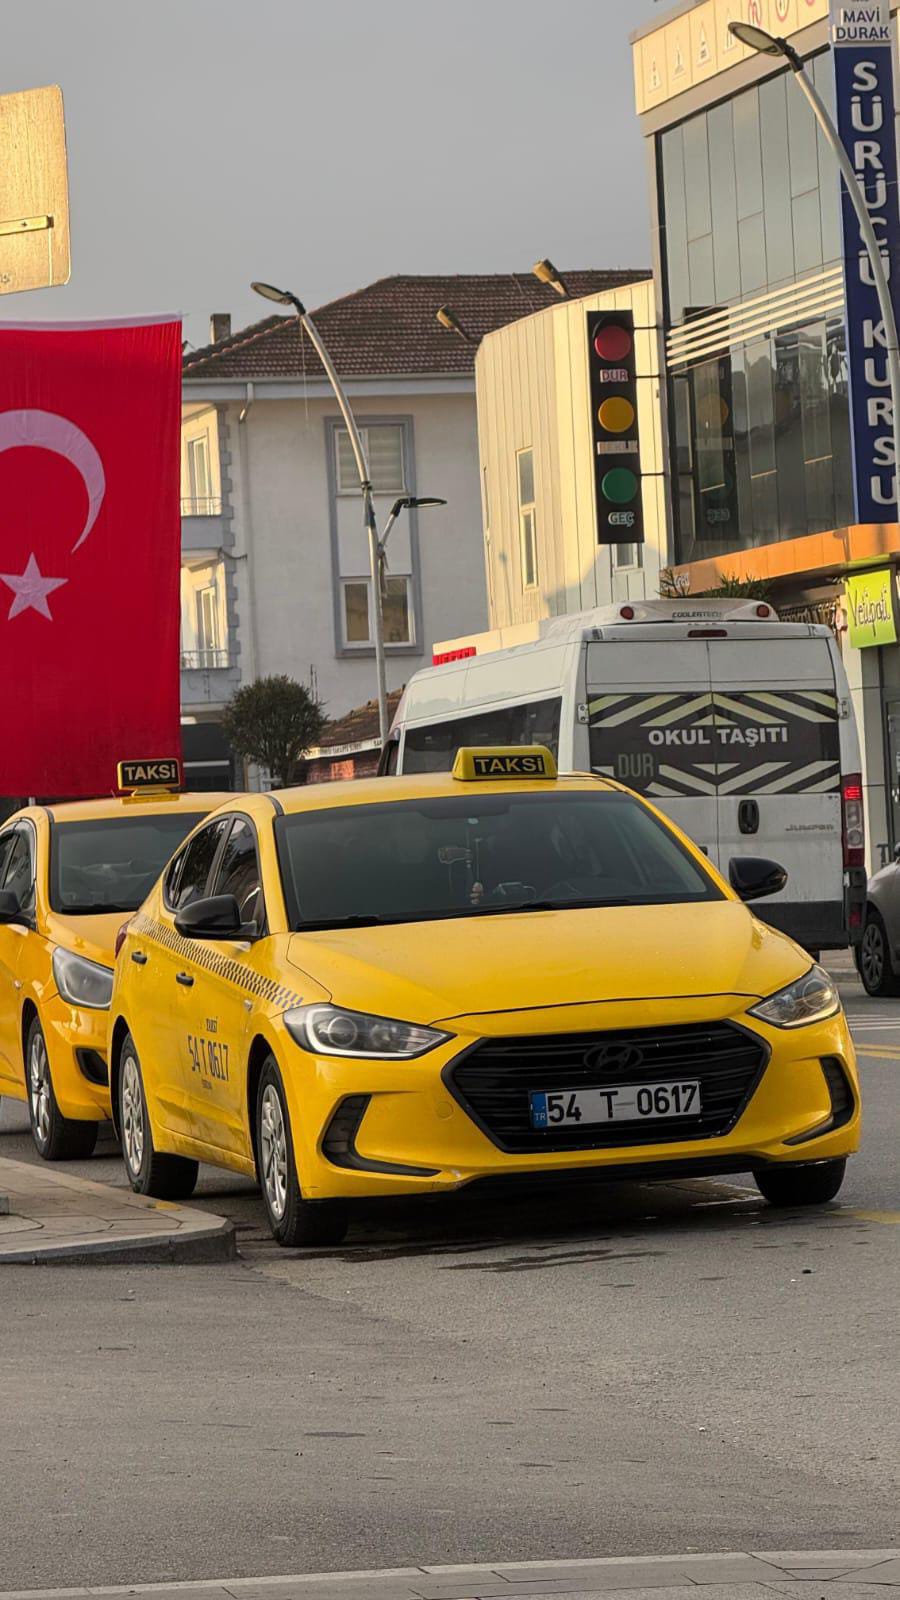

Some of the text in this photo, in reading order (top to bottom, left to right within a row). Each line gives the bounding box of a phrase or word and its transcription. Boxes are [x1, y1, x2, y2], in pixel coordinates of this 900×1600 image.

[842, 6, 880, 23] MAVİ
[835, 26, 890, 39] DURAK
[850, 61, 891, 287] SÜRÜCÜ
[599, 368, 629, 383] DUR
[608, 511, 634, 527] GEÇ
[648, 727, 788, 747] OKUL TAŞITI
[617, 753, 654, 778] DUR
[188, 1035, 229, 1082] 54 T 0617
[547, 1084, 698, 1123] 54 T 0617
[535, 1112, 546, 1121] TR
